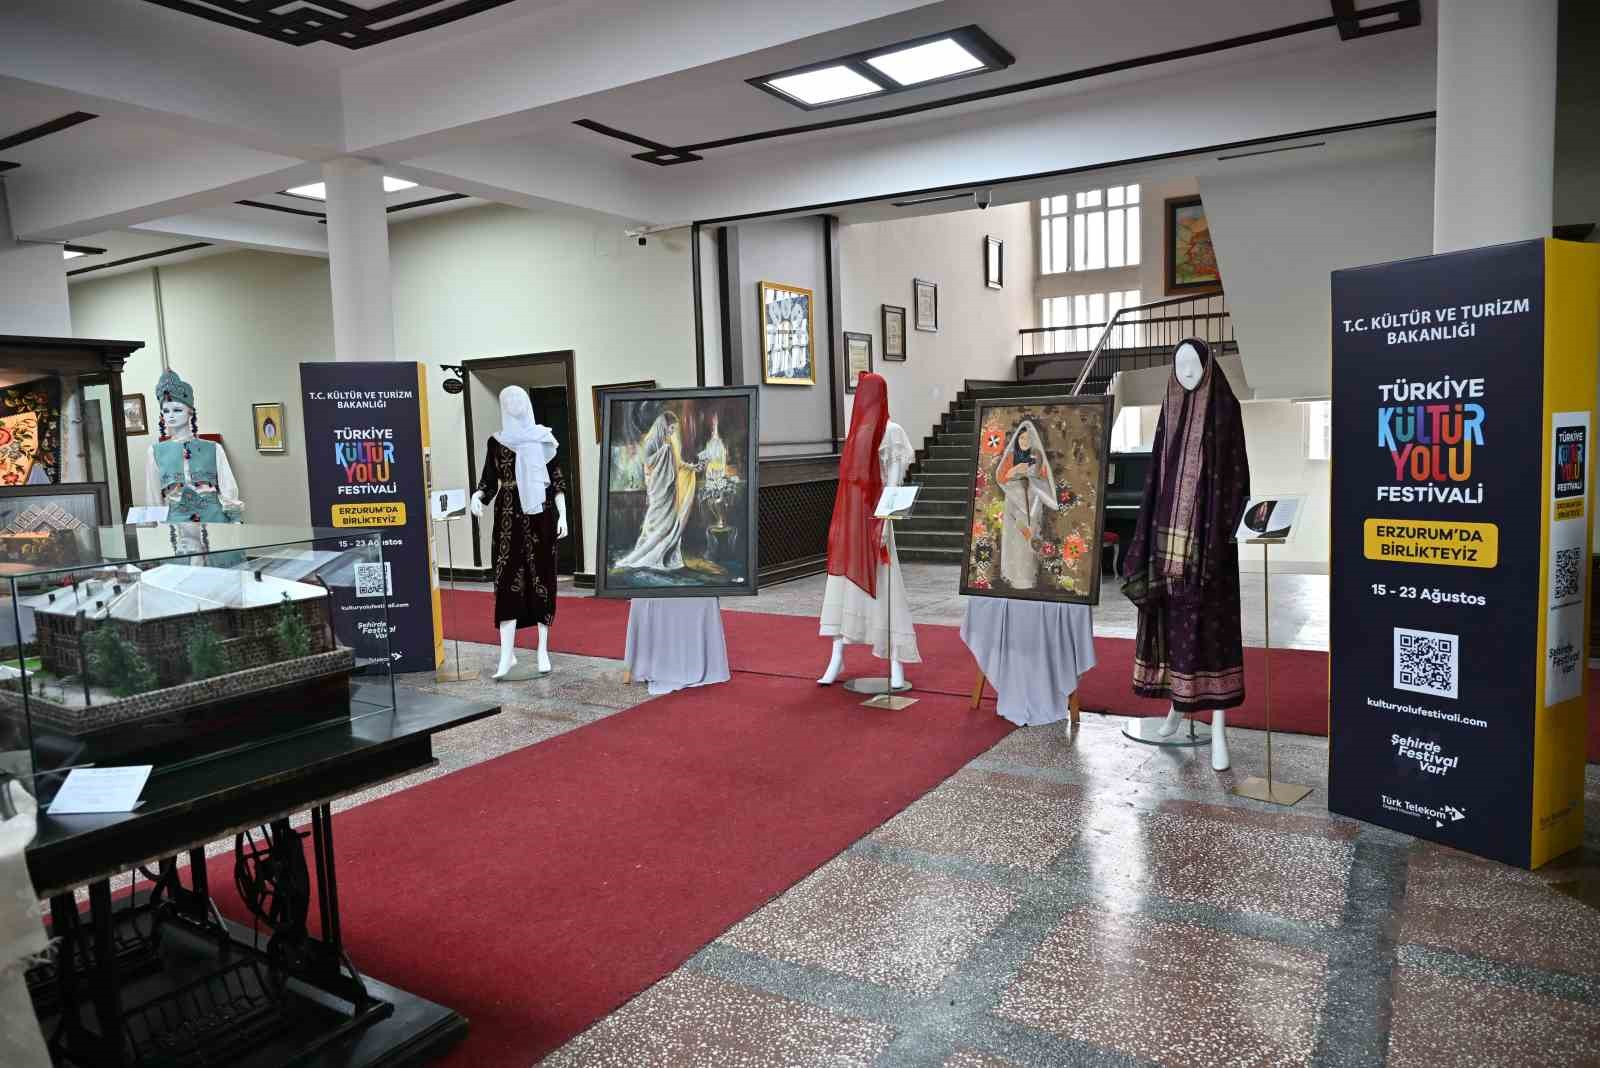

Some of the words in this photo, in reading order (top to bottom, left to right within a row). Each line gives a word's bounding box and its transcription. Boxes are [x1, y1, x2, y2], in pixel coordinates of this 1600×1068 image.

[1343, 320, 1368, 332] T.C.
[1371, 310, 1431, 330] KÜLTÜR
[1435, 308, 1456, 322] VE
[1461, 298, 1530, 320] TURİZM
[1387, 321, 1476, 345] BAKANLIĞI
[309, 392, 326, 400] T.C.
[327, 390, 362, 400] KÜLTÜR
[364, 391, 377, 399] VE
[378, 389, 412, 399] TURİZM
[1378, 375, 1485, 401] TÜRKİYE
[337, 399, 387, 408] BAKANLIĞI
[334, 427, 393, 440] TÜRKİYE
[1377, 403, 1485, 449] KÜLTÜR
[335, 441, 395, 466] KÜLTÜR
[1391, 442, 1472, 481] YOLU
[345, 463, 390, 483] YOLU
[338, 482, 397, 495] FESTİVALİ
[1377, 483, 1484, 503] FESTİVALİ
[342, 516, 397, 525] BİRLİKTEYİZ
[339, 540, 348, 548] 15
[1376, 525, 1483, 543] ERZURUM'DA
[1381, 542, 1478, 562] BİRLİKTEYİZ
[1371, 584, 1386, 595] 15
[1399, 586, 1417, 598] 23
[1420, 588, 1486, 605] Ağustos
[1367, 697, 1488, 728] kulturyolufestivali.com
[1391, 734, 1441, 753] Şehirde
[1398, 746, 1459, 768] Festival
[1419, 761, 1447, 776] Var!
[1381, 794, 1402, 808] Türk
[1404, 800, 1446, 820] Telekom
